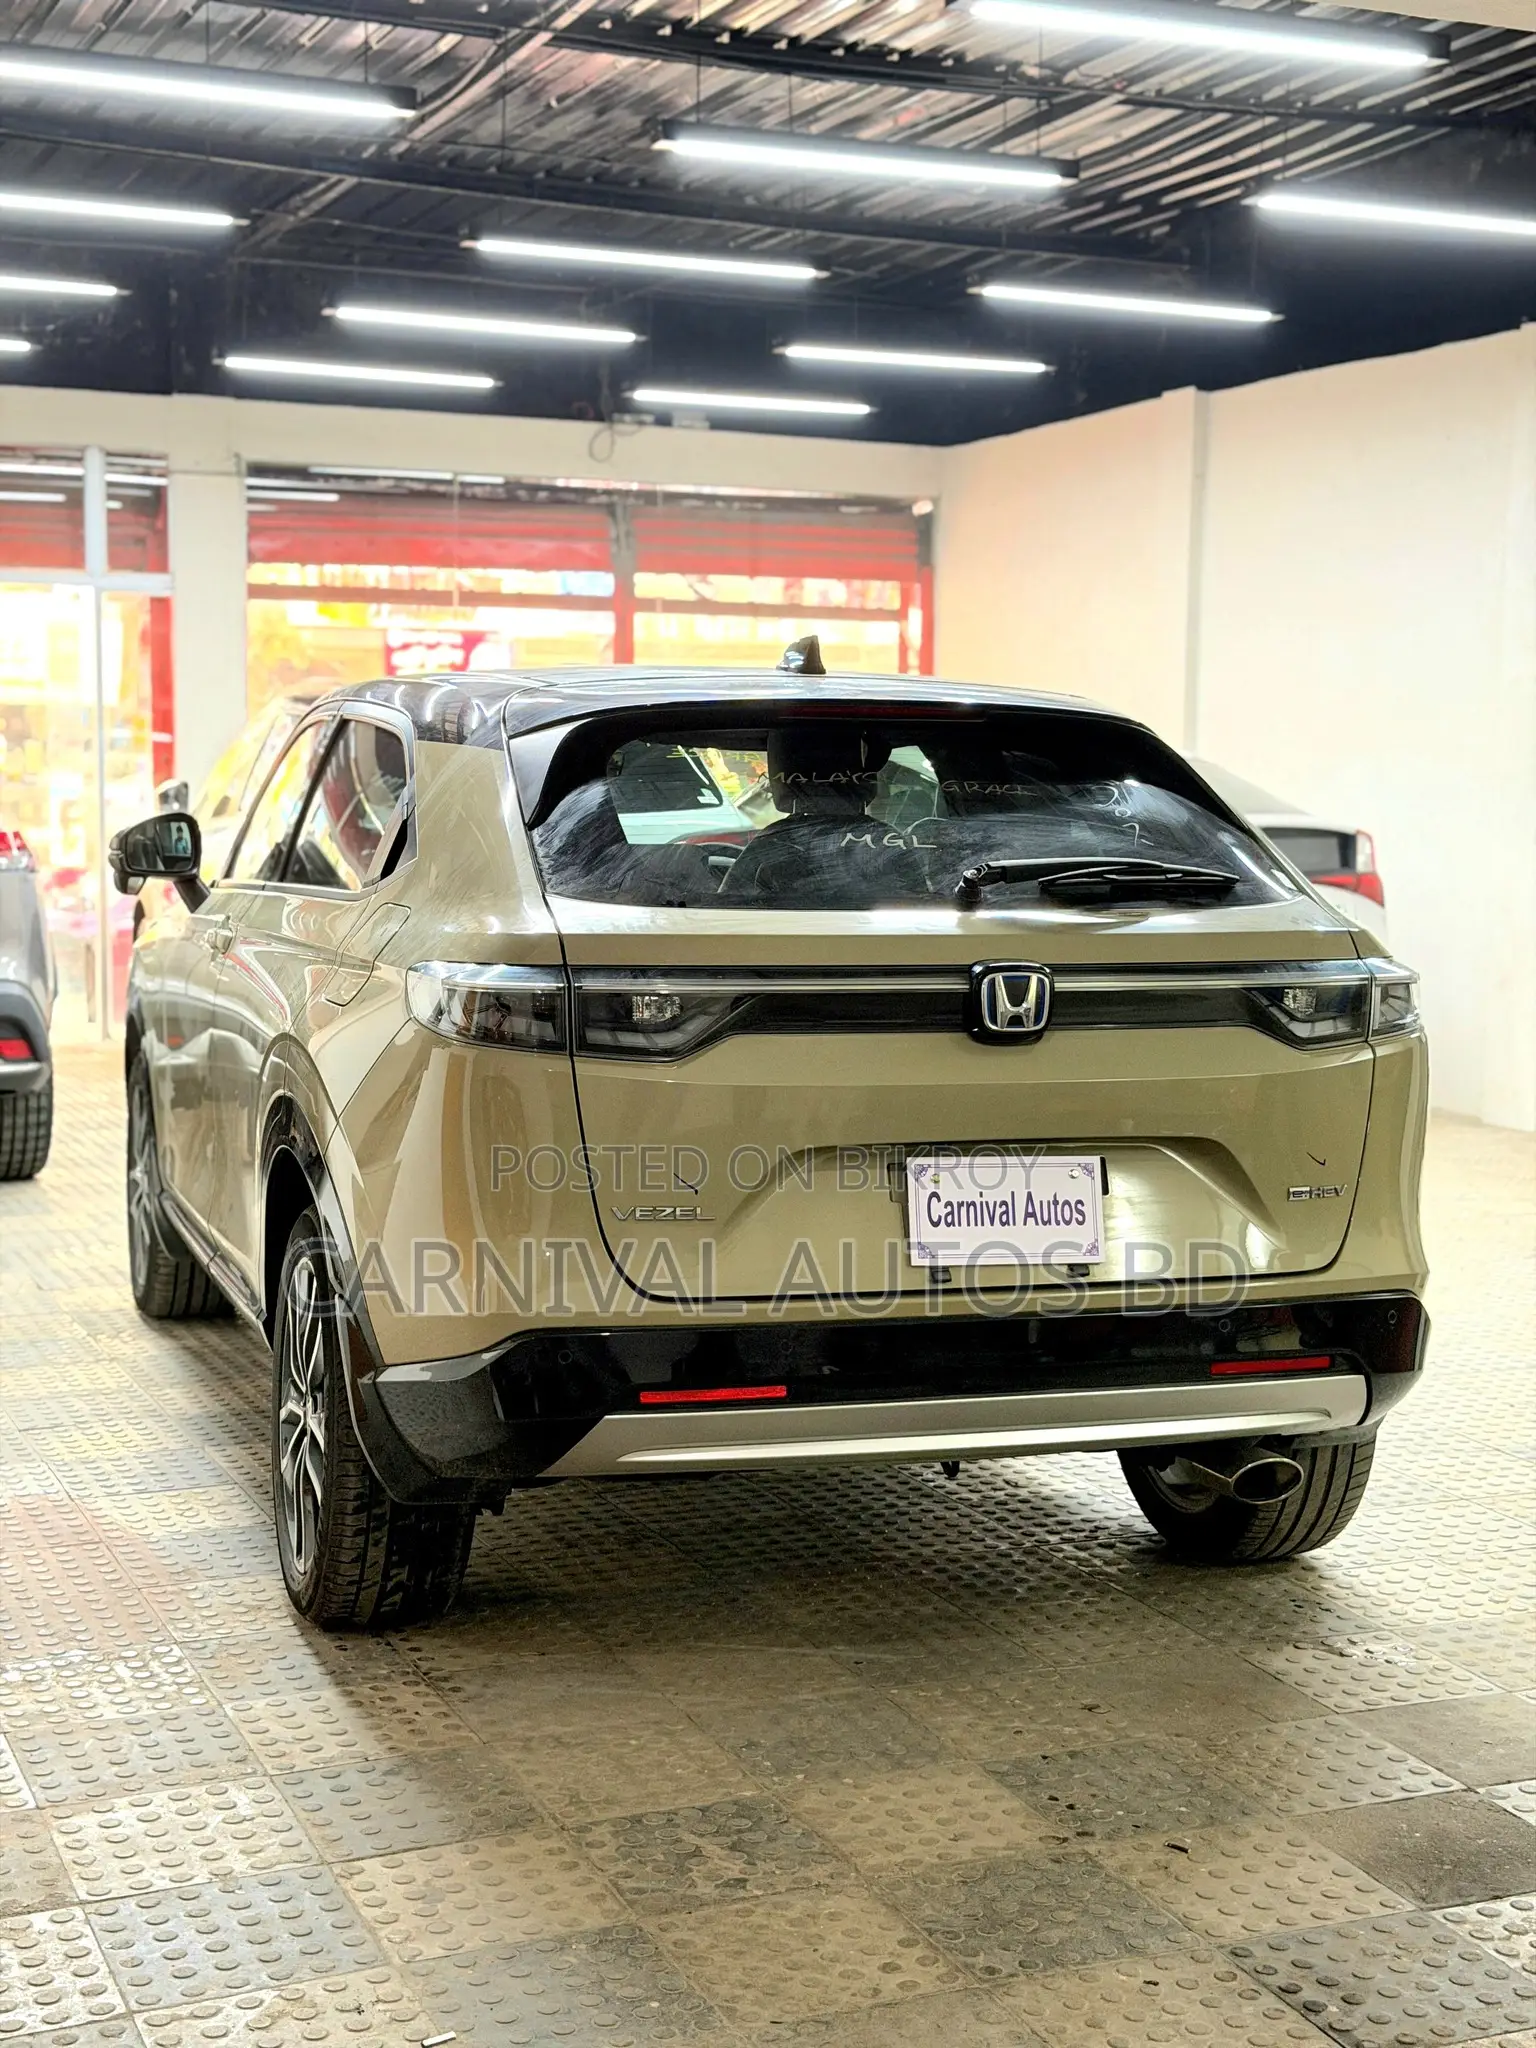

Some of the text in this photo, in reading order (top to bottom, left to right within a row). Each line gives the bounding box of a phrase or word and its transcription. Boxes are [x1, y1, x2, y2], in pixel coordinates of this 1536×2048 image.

[840, 831, 937, 850] MGL
[610, 1205, 716, 1221] VEZEL
[926, 1191, 1087, 1228] Carnival Autos
